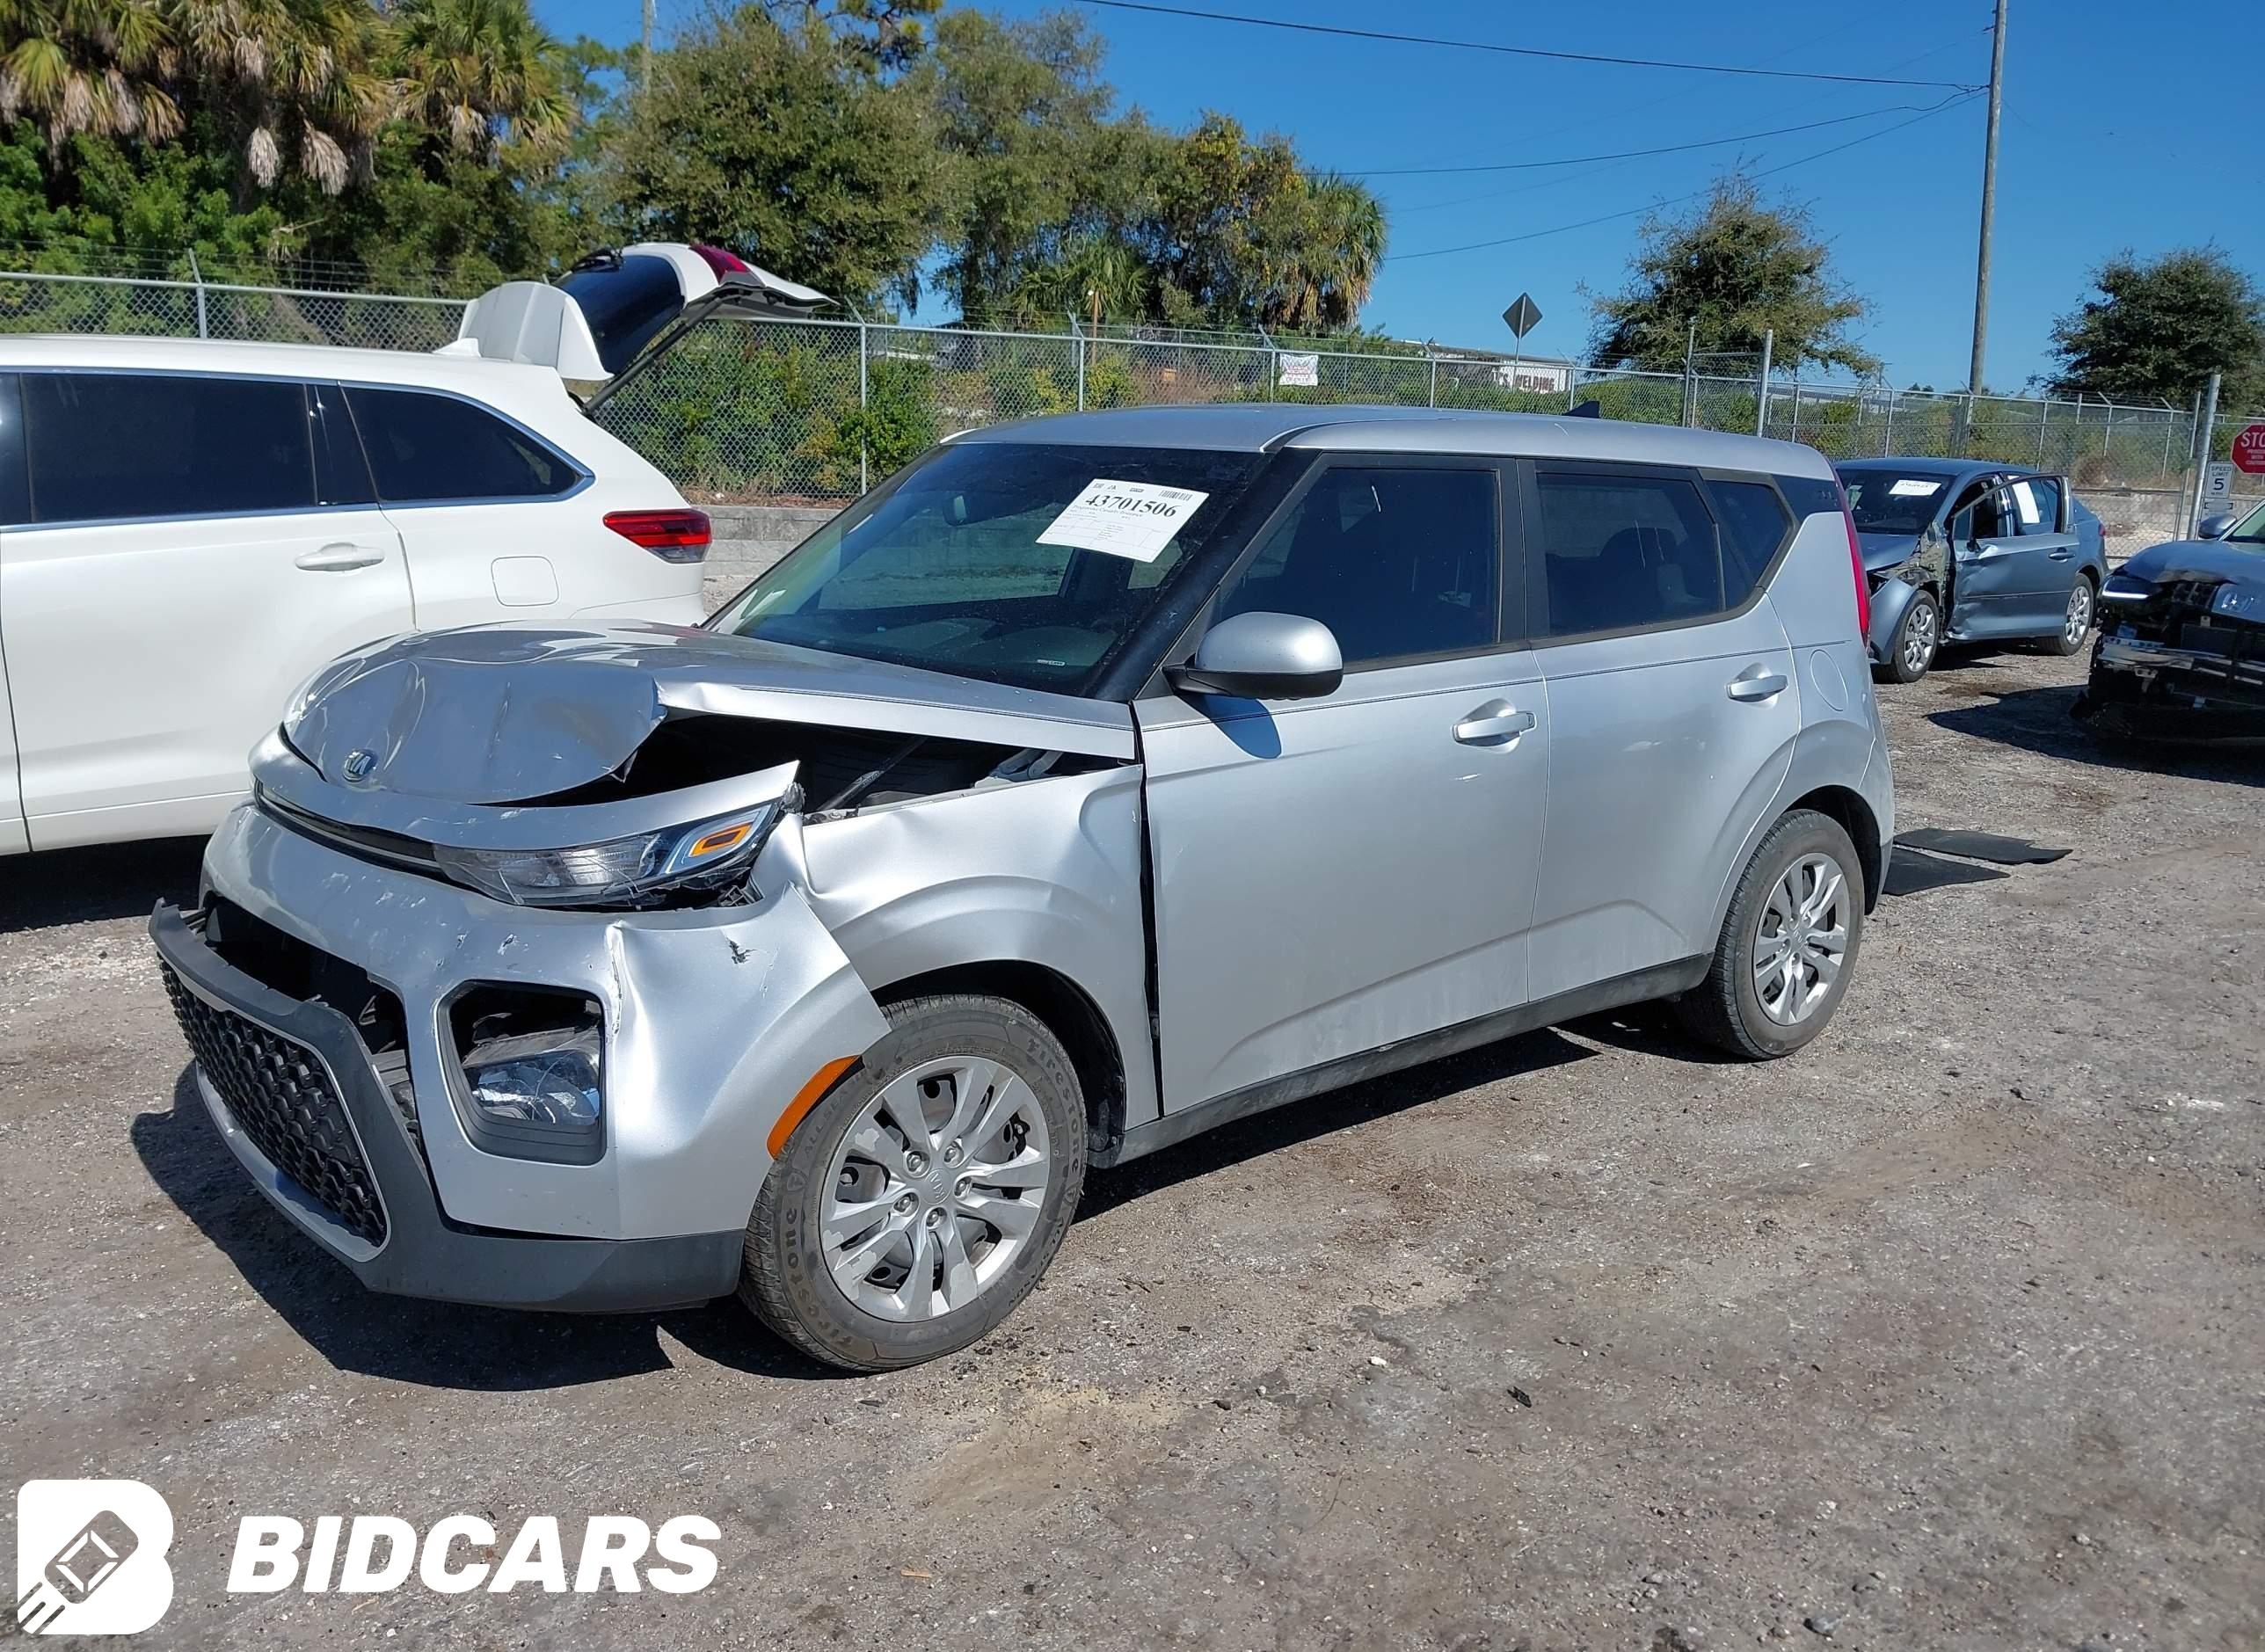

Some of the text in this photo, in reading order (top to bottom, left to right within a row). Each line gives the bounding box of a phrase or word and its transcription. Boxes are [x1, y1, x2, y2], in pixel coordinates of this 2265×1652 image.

[1515, 374, 1555, 391] WELDING
[2240, 432, 2265, 448] STO
[2213, 477, 2225, 491] 5
[1086, 494, 1182, 518] 43701506
